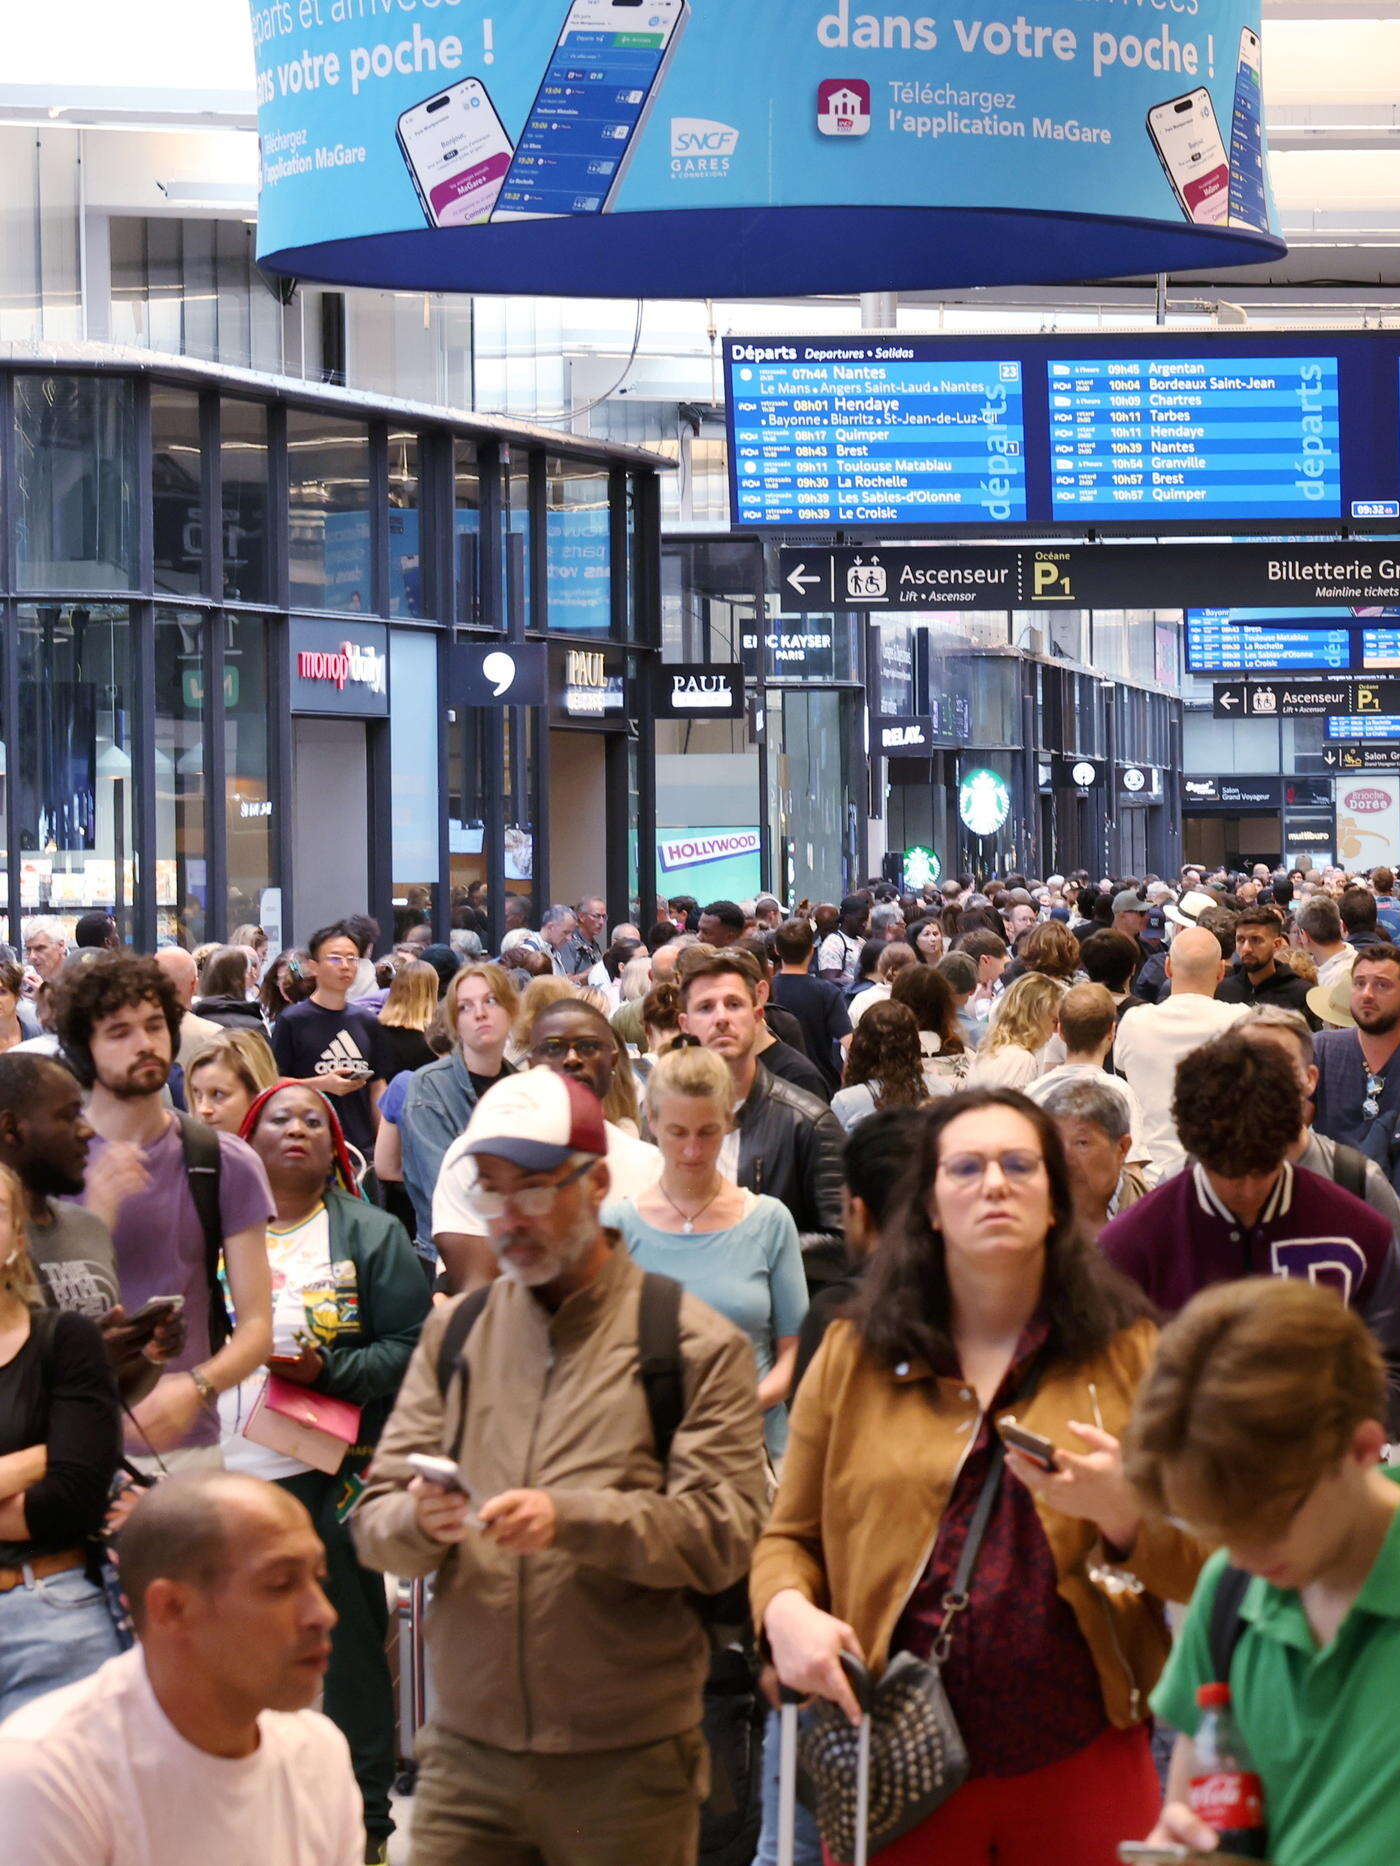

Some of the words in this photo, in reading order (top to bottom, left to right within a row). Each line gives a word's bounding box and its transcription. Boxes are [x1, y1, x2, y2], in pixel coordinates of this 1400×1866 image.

[816, 0, 937, 51] dans
[953, 16, 1078, 60] votre
[1093, 23, 1199, 77] poche
[1207, 34, 1215, 79] !
[277, 49, 341, 96] votre
[351, 22, 463, 95] poche
[483, 18, 495, 65] !
[889, 80, 1016, 112] Téléchargez
[889, 109, 1026, 142] l'application
[1032, 117, 1112, 144] MaGare
[674, 132, 734, 151] SNCF
[315, 143, 366, 170] MaGare
[671, 157, 730, 172] GARES
[732, 345, 797, 363] Départs
[805, 347, 864, 362] Departures
[875, 347, 914, 359] Salidas
[792, 369, 828, 380] 07h44
[834, 365, 887, 380] Nantes
[1108, 363, 1140, 375] 09h45
[1149, 362, 1205, 376] Argentan
[760, 383, 775, 394] Le
[779, 382, 811, 394] Mans
[820, 381, 862, 397] Angers
[865, 381, 931, 393] Saint-Laud
[941, 380, 984, 393] Nantes
[1109, 380, 1141, 391] 10h04
[1149, 378, 1207, 390] Bordeaux
[1210, 377, 1275, 390] Saint-Jean
[794, 400, 828, 411] 08h01
[834, 397, 899, 414] Hendaye
[1110, 396, 1141, 407] 10h09
[1149, 394, 1202, 406] Chartres
[769, 414, 821, 428] Bayonne
[831, 412, 874, 426] Biarritz
[1110, 411, 1141, 422] 10h11
[1150, 410, 1191, 422] Tarbes
[795, 431, 828, 442] 08h17
[836, 428, 889, 443] Quimper
[1110, 427, 1141, 438] 10h11
[1150, 426, 1204, 440] Hendaye
[1295, 364, 1332, 501] départs
[796, 446, 828, 457] 08h43
[836, 443, 868, 456] Brest
[980, 385, 1018, 519] départs
[1111, 443, 1142, 454] 10h39
[1151, 442, 1195, 454] Nantes
[797, 461, 828, 472] 09h11
[837, 459, 893, 473] Toulouse
[895, 459, 952, 472] Matabiau
[1112, 459, 1143, 470] 10h54
[1151, 457, 1206, 469] Granville
[797, 477, 829, 488] 09h30
[838, 476, 852, 488] La
[855, 475, 908, 488] Rochelle
[1112, 474, 1143, 485] 10h57
[1152, 473, 1184, 485] Brest
[797, 492, 829, 503] 09h39
[839, 491, 859, 503] Les
[861, 490, 961, 503] Sables-d'Olonne
[1112, 490, 1144, 501] 10h57
[1152, 488, 1206, 502] Quimper
[799, 508, 830, 519] 09h39
[839, 508, 855, 519] Le
[856, 507, 898, 519] Croisic
[1034, 550, 1071, 561] Océane
[899, 564, 1009, 586] Ascenseur
[1267, 560, 1374, 581] Billetterie
[899, 591, 918, 602] Lift
[928, 590, 977, 602] Ascensor
[1315, 585, 1365, 598] Mainline
[1368, 586, 1400, 598] tickets
[781, 635, 831, 648] KAYSER
[775, 651, 805, 661] PARIS
[565, 650, 608, 687] PAUL
[672, 675, 732, 692] PAUL
[1282, 690, 1345, 704] Ascenseur
[1364, 751, 1387, 760] Salon
[1221, 786, 1240, 795] Salon
[1221, 793, 1241, 801] Grand
[1241, 793, 1271, 802] Voyageur
[1287, 831, 1330, 841] multiburo
[668, 835, 756, 860] HOLLYWOOD
